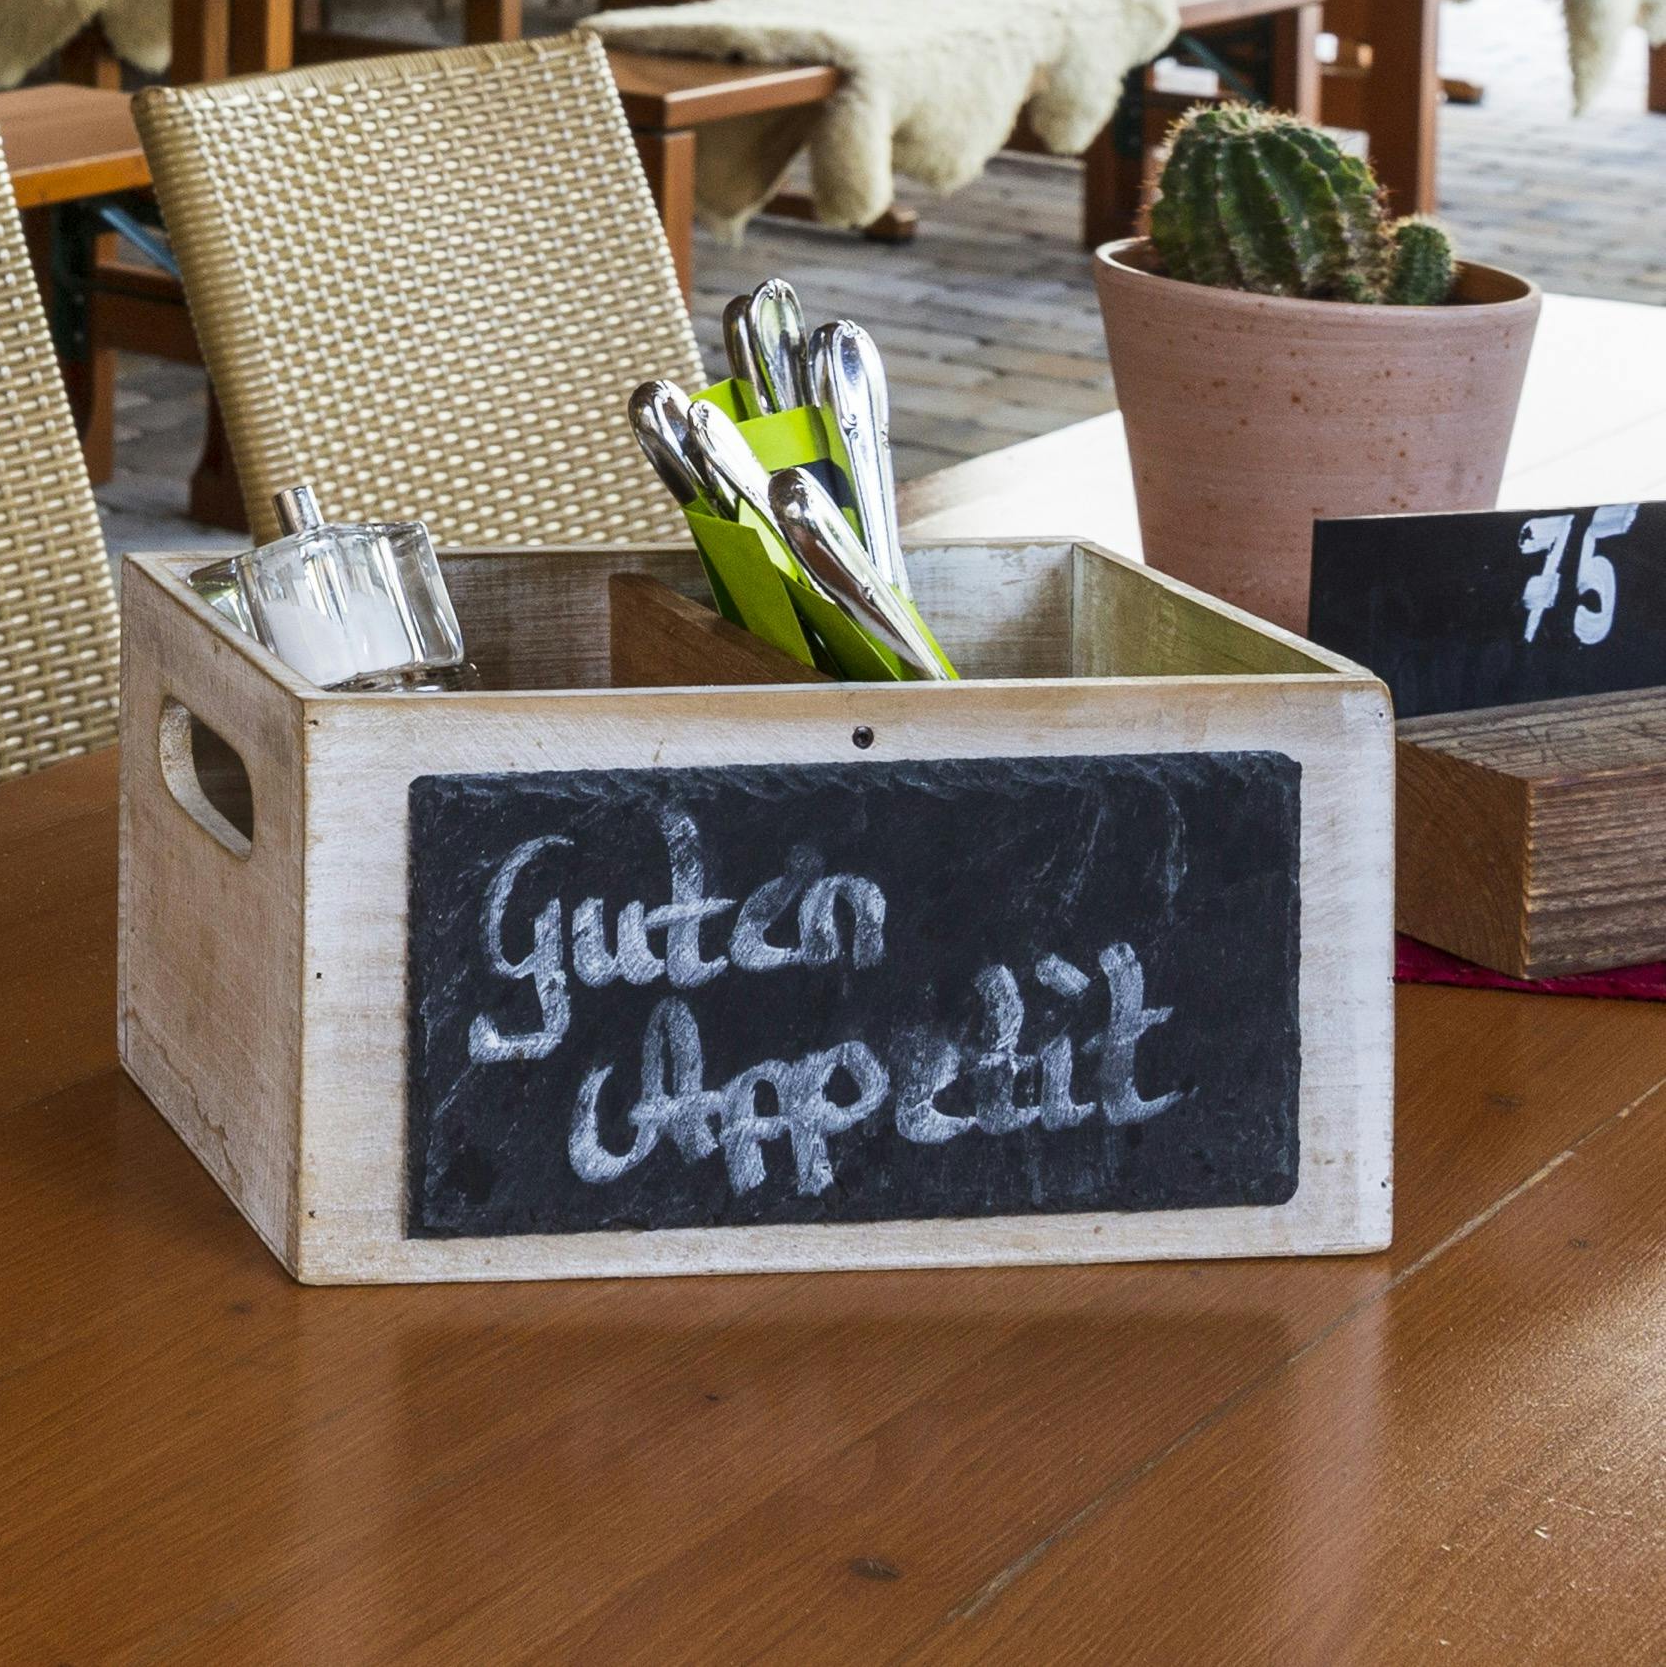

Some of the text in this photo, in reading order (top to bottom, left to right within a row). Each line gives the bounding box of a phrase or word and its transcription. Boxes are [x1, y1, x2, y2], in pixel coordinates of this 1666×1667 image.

[1519, 503, 1640, 646] 75
[468, 810, 888, 1062] Guten
[568, 940, 1199, 1196] Appetit
